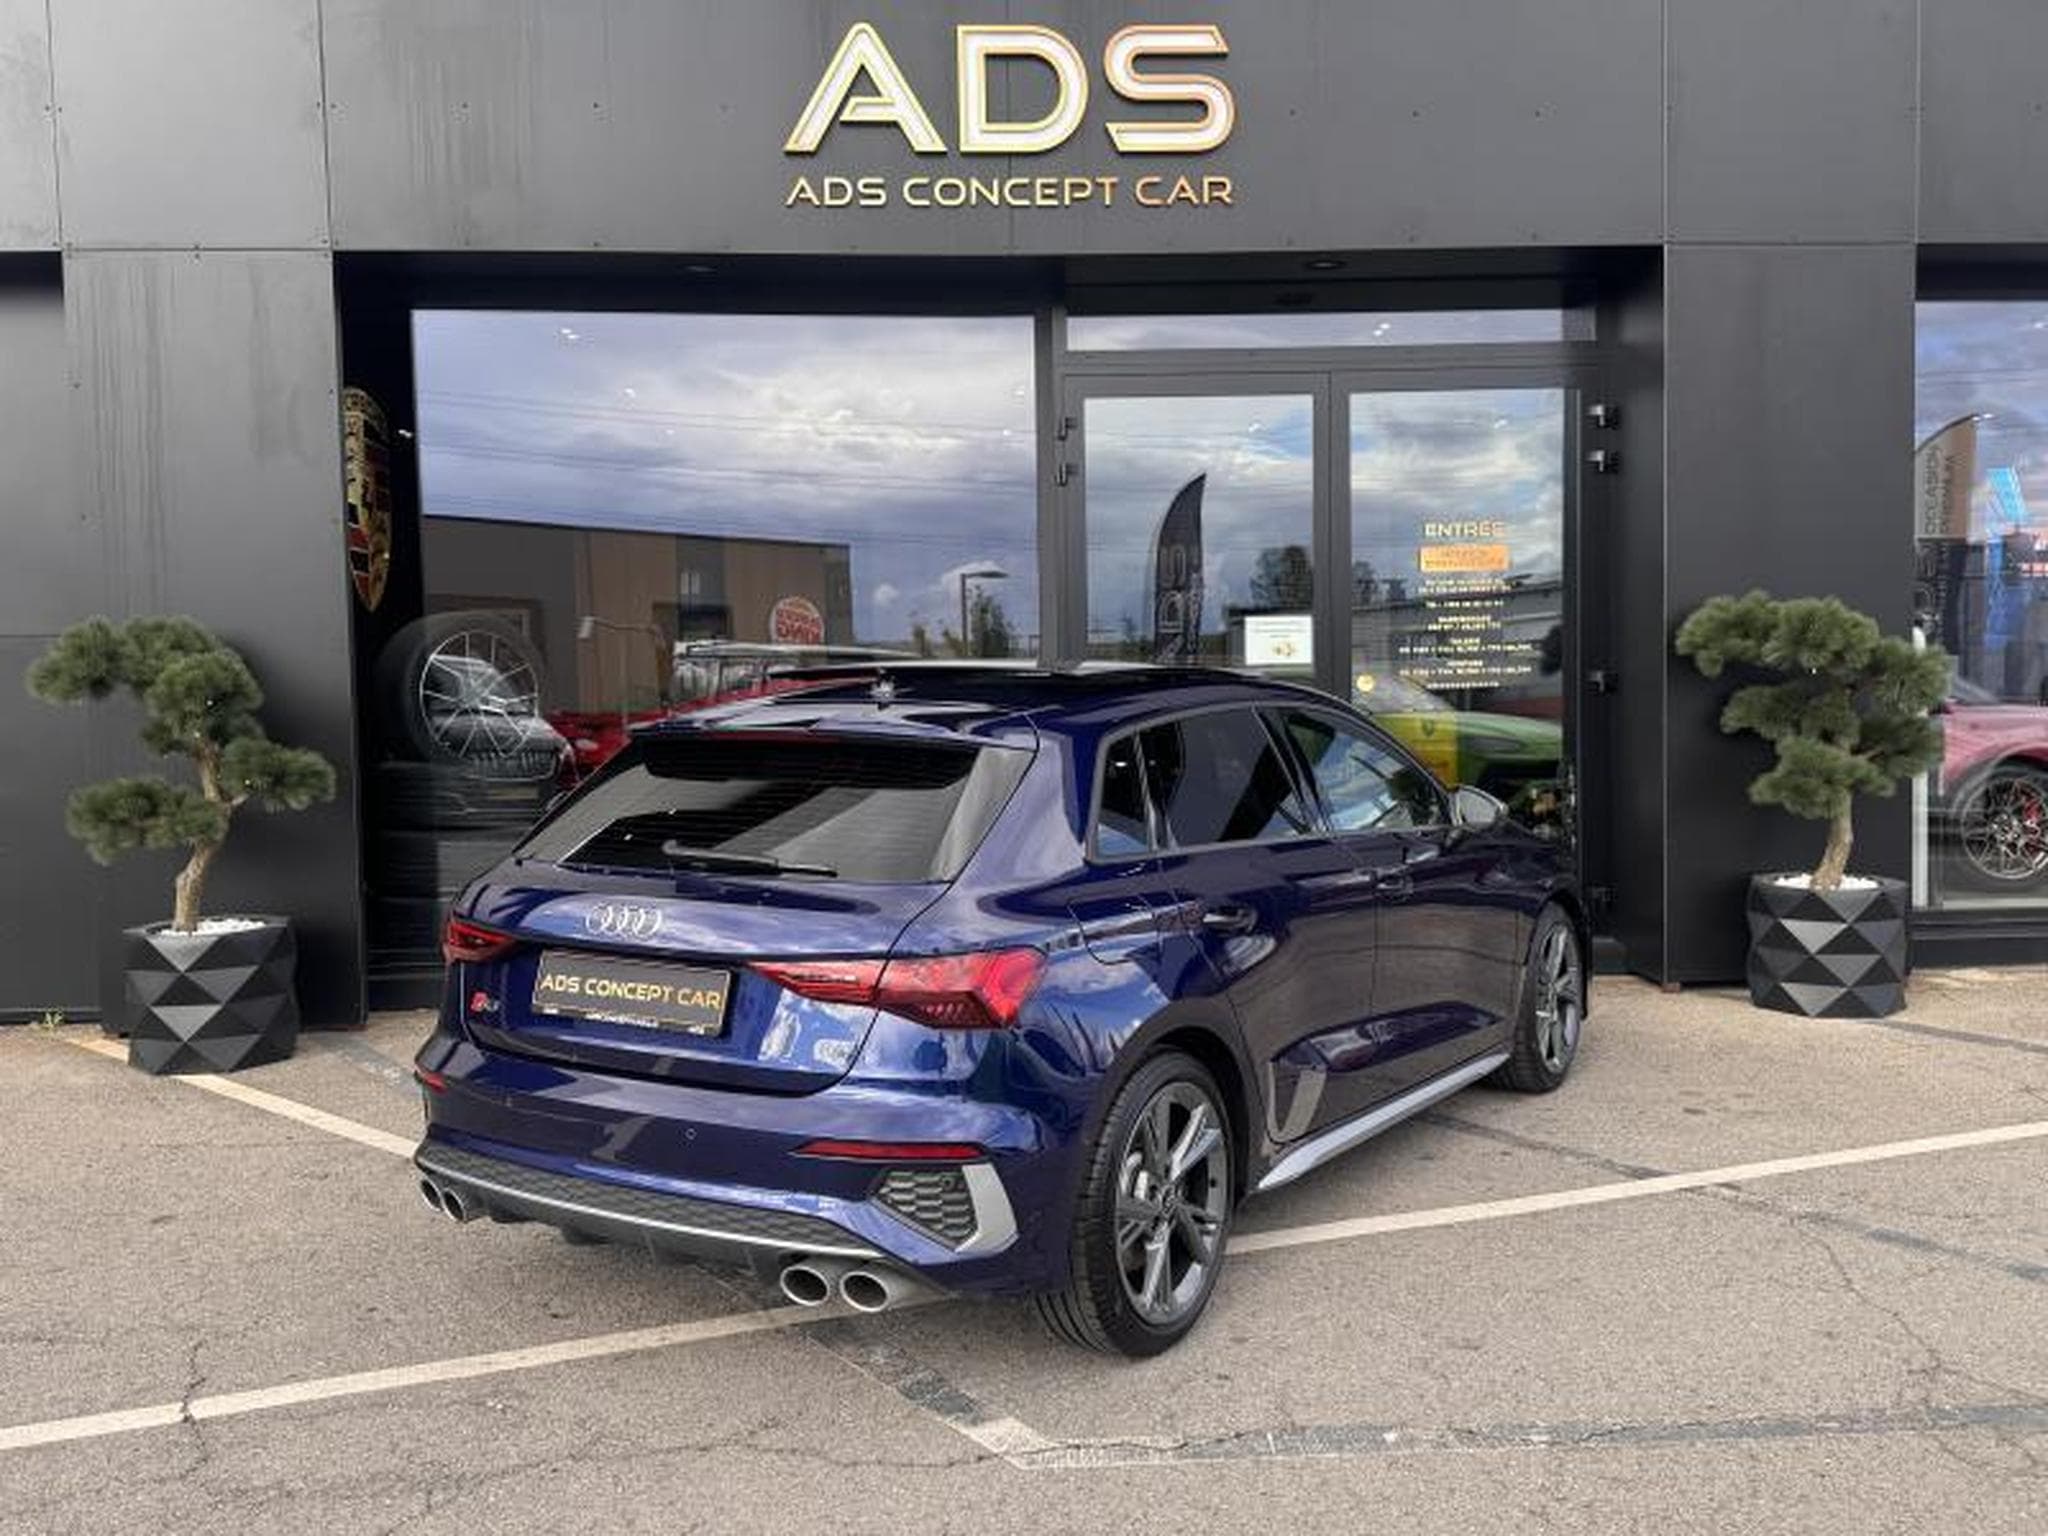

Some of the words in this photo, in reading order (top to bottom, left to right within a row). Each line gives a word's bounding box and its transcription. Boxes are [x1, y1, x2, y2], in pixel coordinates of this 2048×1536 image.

[784, 22, 1236, 154] ADS
[785, 177, 888, 207] ADS
[903, 176, 1119, 206] CONCEPT
[1135, 176, 1235, 205] CAR
[540, 974, 582, 993] ADS
[585, 978, 673, 1003] CONCEPT
[677, 988, 721, 1010] CAR
